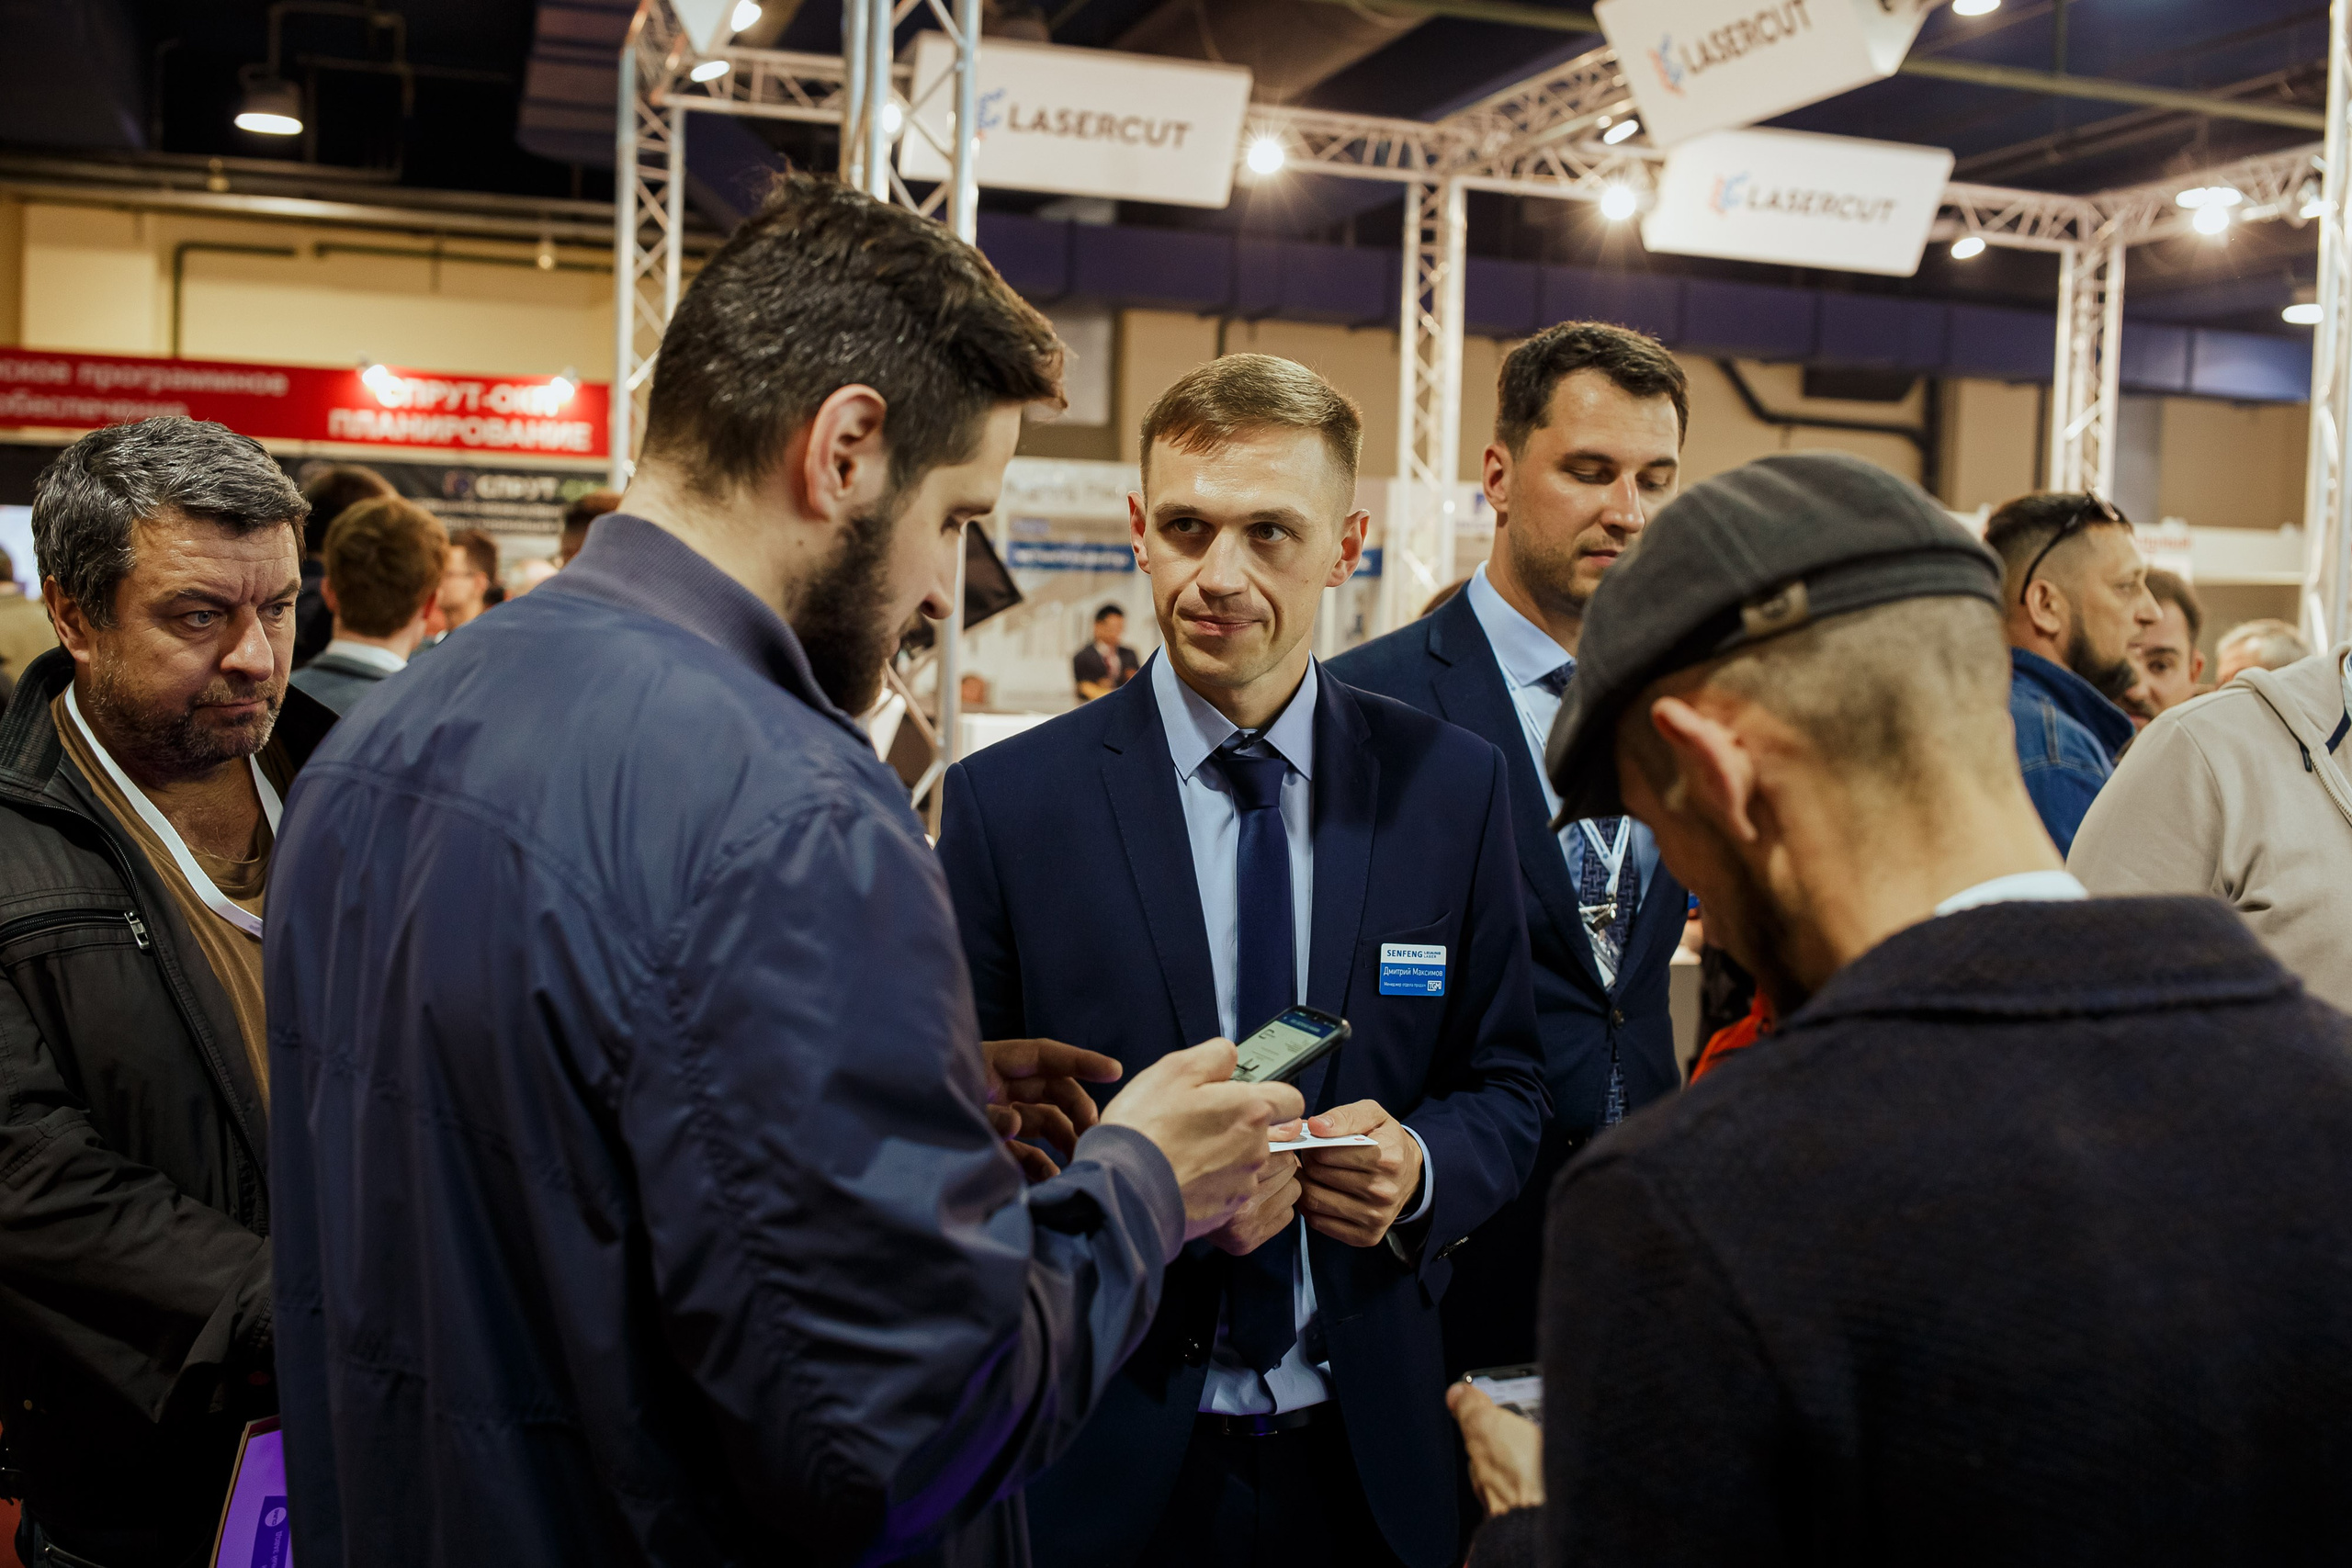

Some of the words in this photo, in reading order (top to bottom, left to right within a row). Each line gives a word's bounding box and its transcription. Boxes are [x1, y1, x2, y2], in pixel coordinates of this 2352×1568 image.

[1679, 0, 1814, 75] LASERCUT
[1009, 105, 1192, 150] LASERCUT
[1747, 185, 1899, 223] LASERCUT
[328, 408, 593, 452] ПЛАНИРОВАНИЕ
[1383, 966, 1411, 976] Дмитрий
[1413, 968, 1443, 976] Максимов
[1387, 949, 1423, 958] SENFENG
